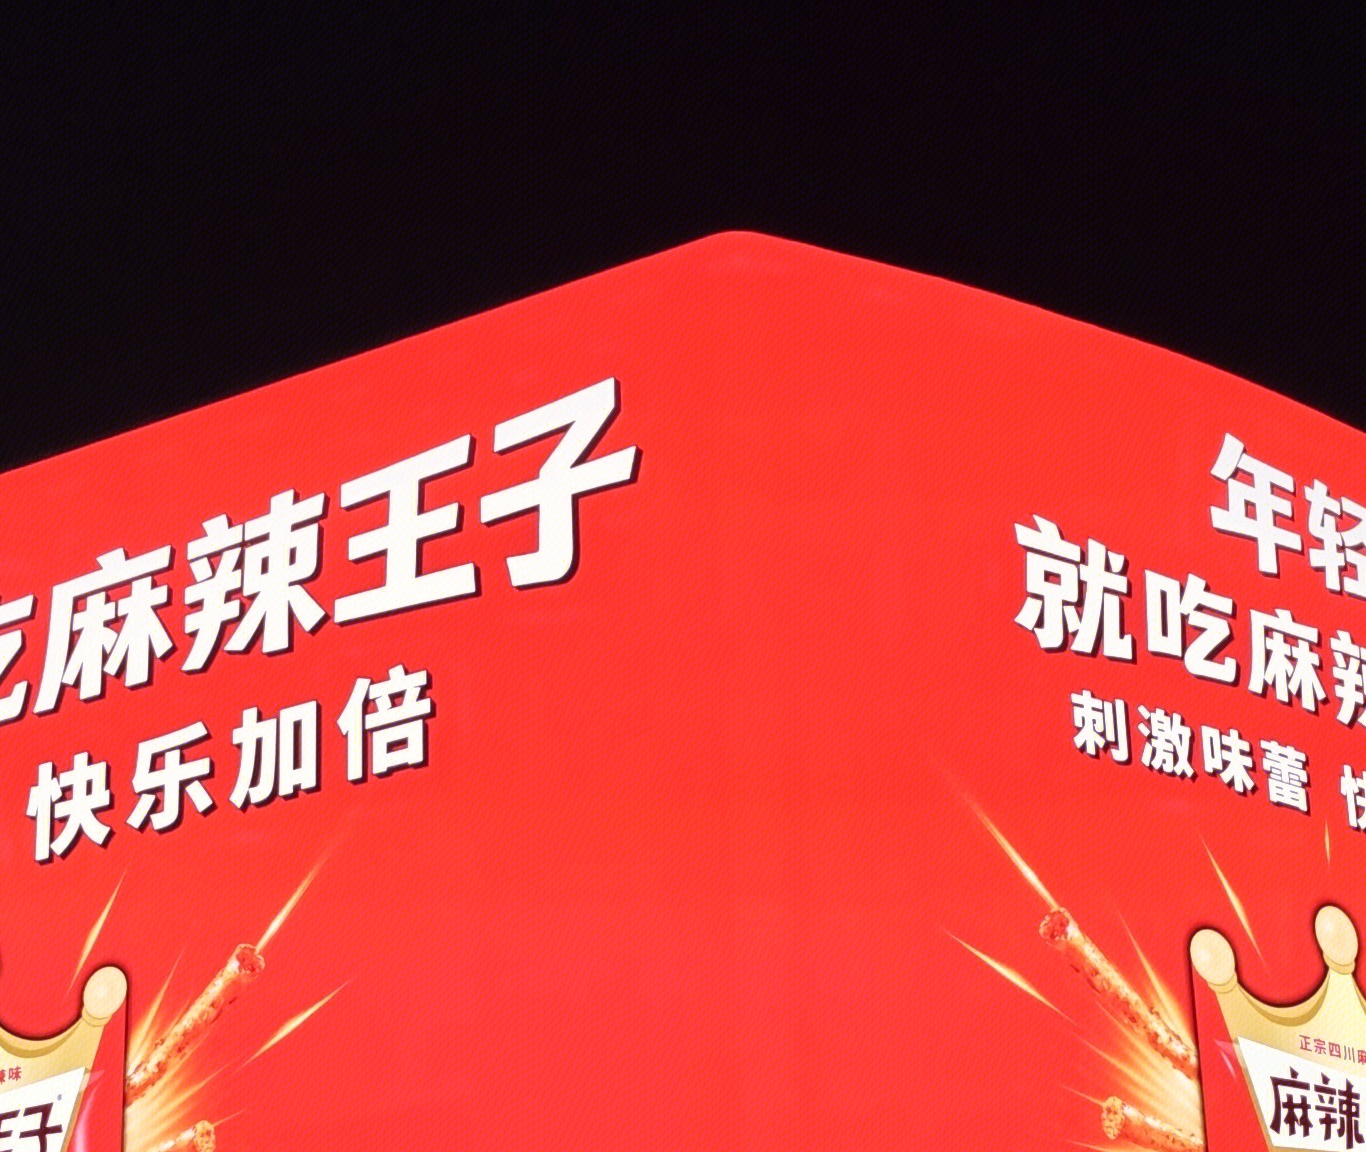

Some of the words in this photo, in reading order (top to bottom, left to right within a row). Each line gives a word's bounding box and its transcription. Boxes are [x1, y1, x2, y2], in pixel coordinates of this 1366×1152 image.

[25, 664, 435, 864] 快乐加倍
[1070, 689, 1312, 816] 刺激味蕾
